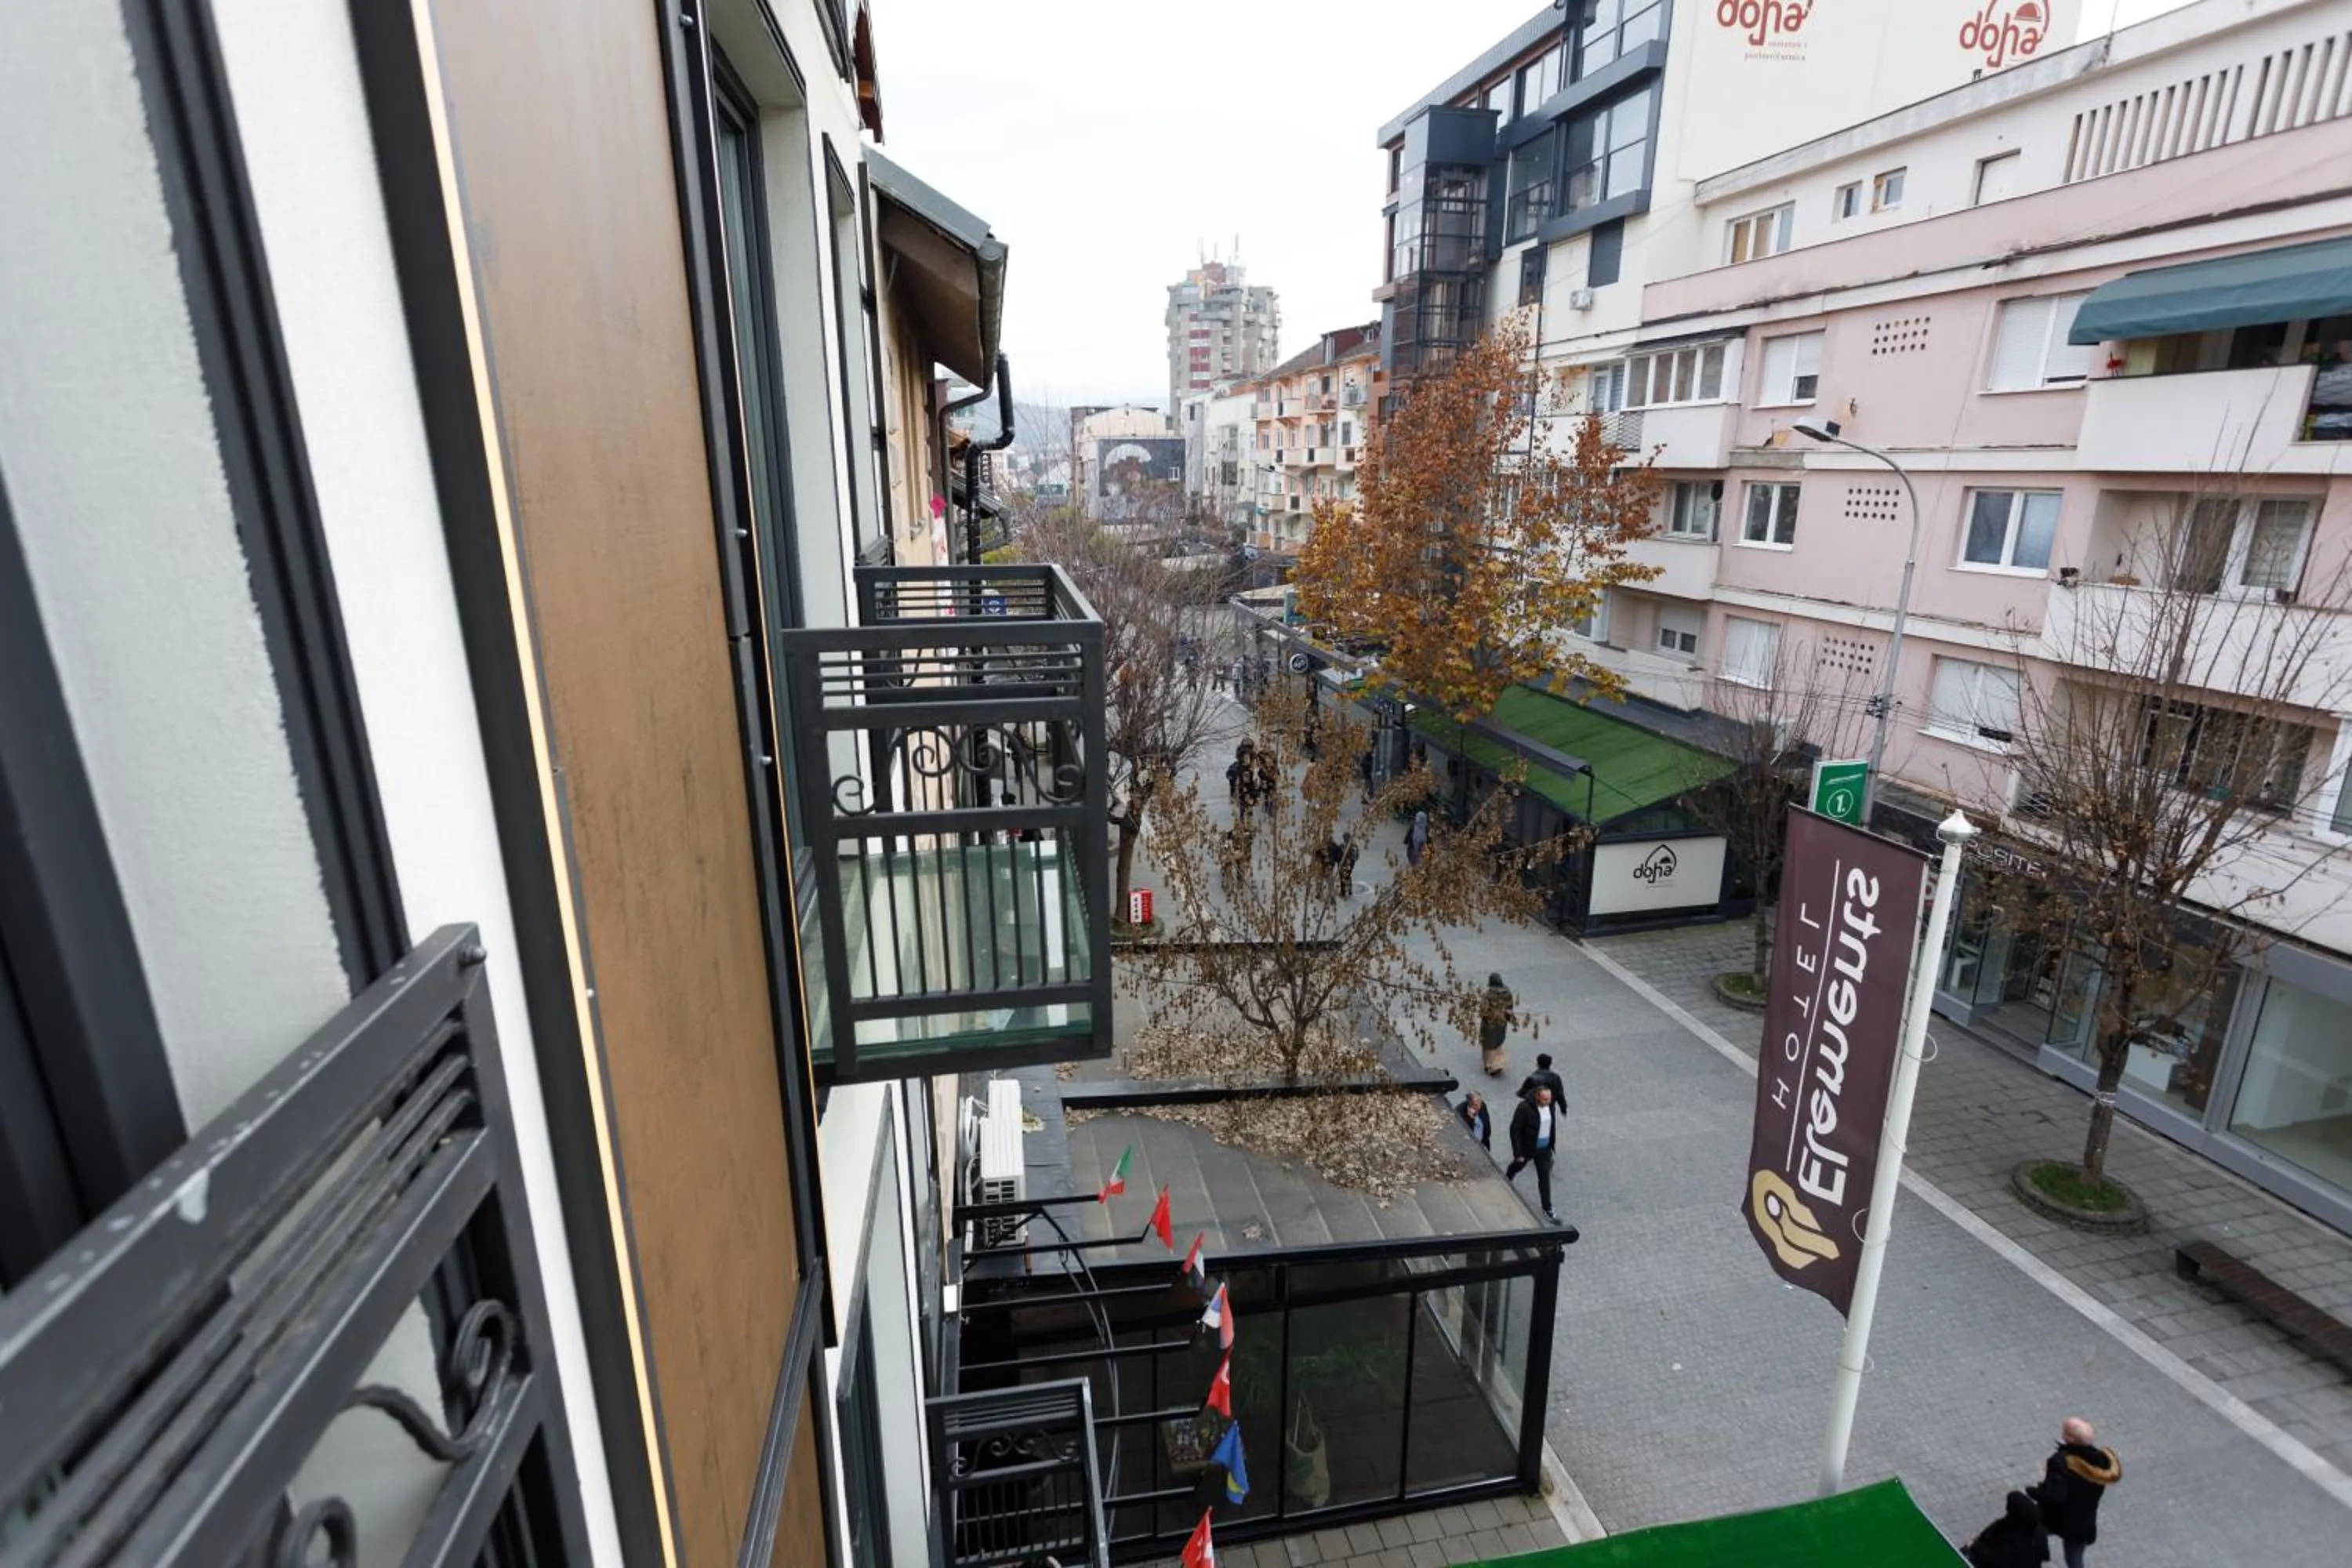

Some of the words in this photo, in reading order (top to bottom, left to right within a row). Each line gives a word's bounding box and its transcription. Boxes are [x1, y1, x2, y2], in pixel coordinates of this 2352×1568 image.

[1717, 0, 1806, 45] doha
[1958, 10, 2042, 67] doha
[1633, 862, 1673, 884] doha
